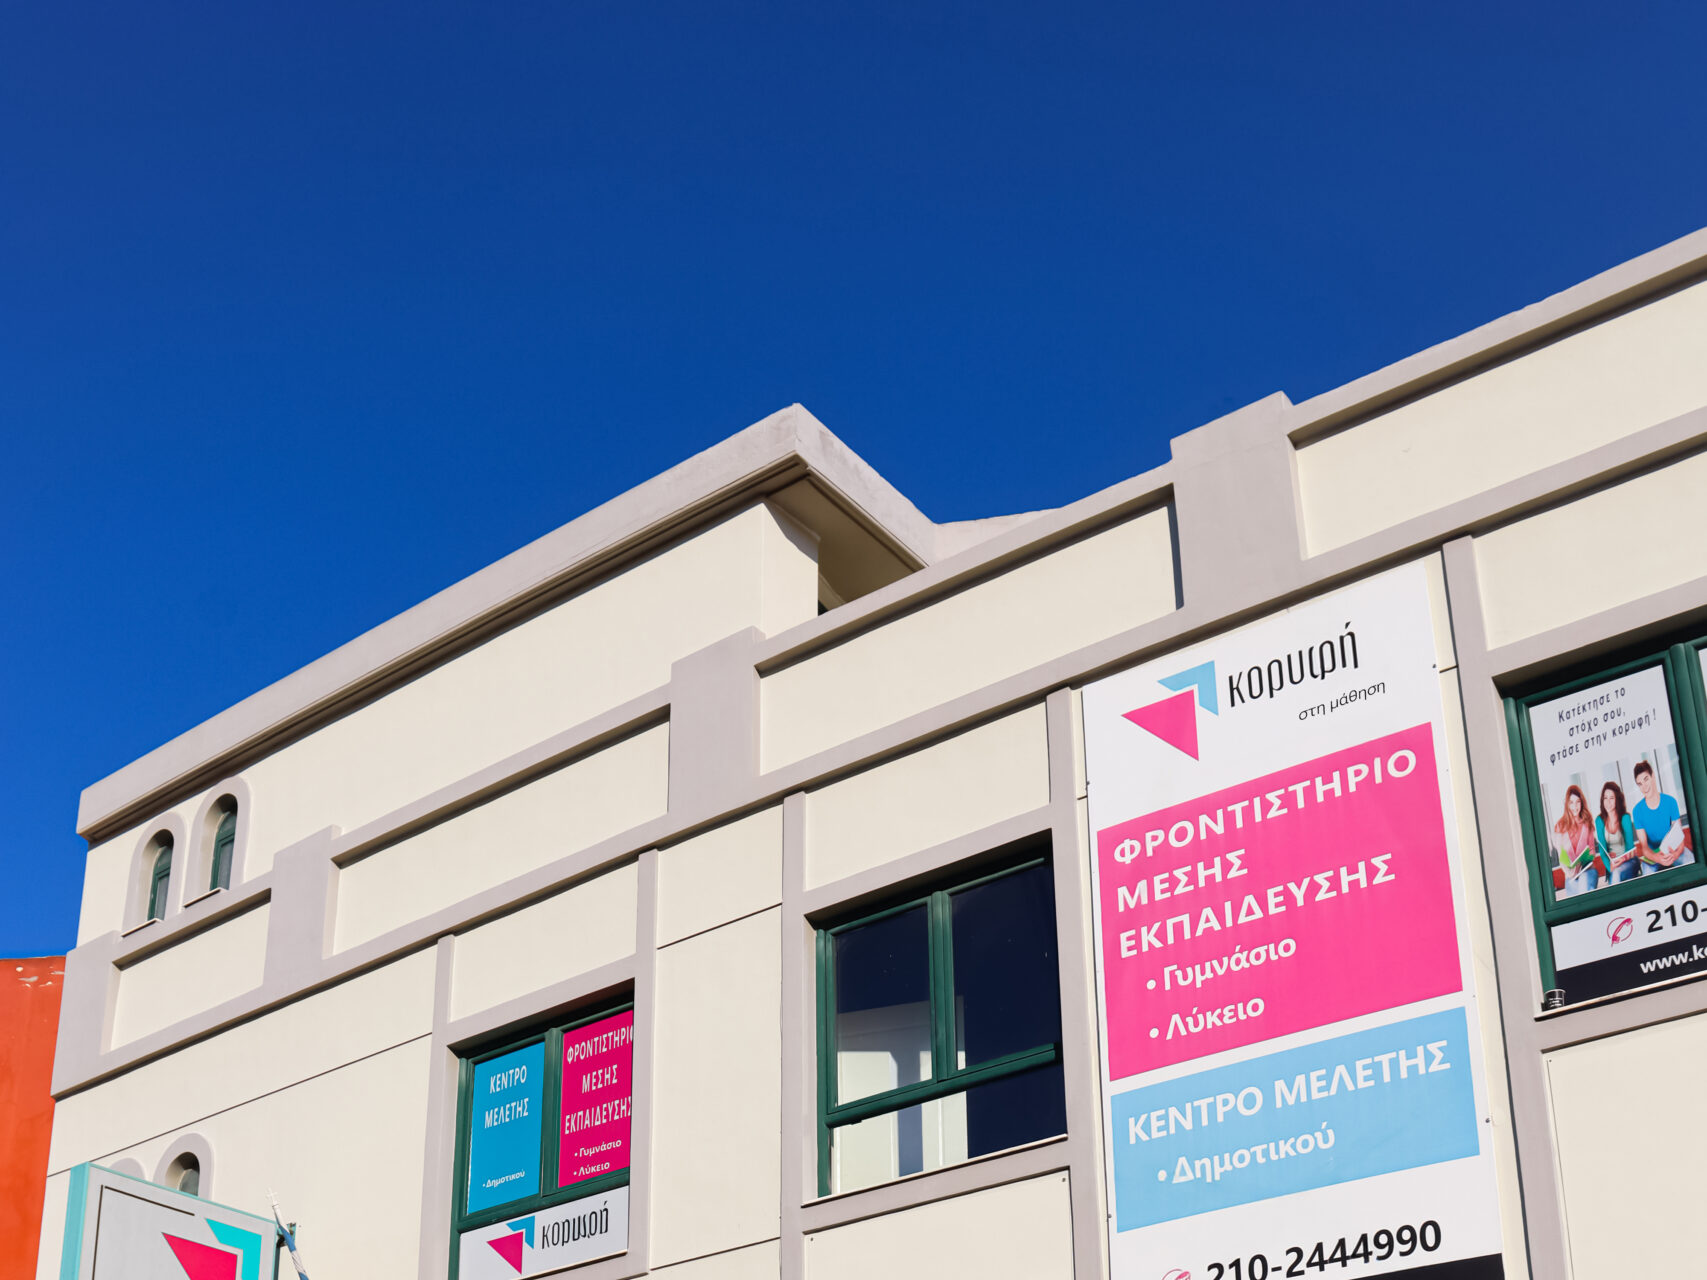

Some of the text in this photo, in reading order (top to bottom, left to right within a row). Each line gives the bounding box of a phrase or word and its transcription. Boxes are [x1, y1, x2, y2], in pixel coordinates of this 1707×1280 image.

[1228, 621, 1360, 708] κορυφή
[1298, 681, 1386, 721] στη μάθηση
[1558, 687, 1626, 724] Κατέκτησε το
[1568, 717, 1599, 737] στόχο
[1549, 743, 1580, 767] φτάσε
[1584, 731, 1608, 750] στην
[1113, 748, 1417, 865] ΦΡΟΝΤΙΣΤΗΡΙΟ
[1116, 848, 1249, 913] ΜΕΣΗΣ
[1119, 853, 1396, 959] ΕΚΠΑΙΔΕΥΣΗΣ
[1163, 937, 1297, 991] Γυμνάσιο
[1165, 996, 1265, 1041] Λύκειο
[489, 1064, 528, 1095] ΚΕΝΤΡΟ
[581, 1064, 618, 1094] ΜΕΣΗΣ
[1128, 1040, 1451, 1145] ΚΕΝΤΡΟ ΜΕΛΕΤΗΣ
[484, 1097, 529, 1130] ΜΕΛΕΤΗΣ
[564, 1095, 632, 1135] ΕΚΠΑΙΔΕΥΣΗΣ
[579, 1139, 622, 1158] Γυμνάσιο
[1171, 1122, 1337, 1184] Δημοτικού
[485, 1169, 526, 1189] Δημοτικού
[578, 1161, 611, 1177] Λύκειο
